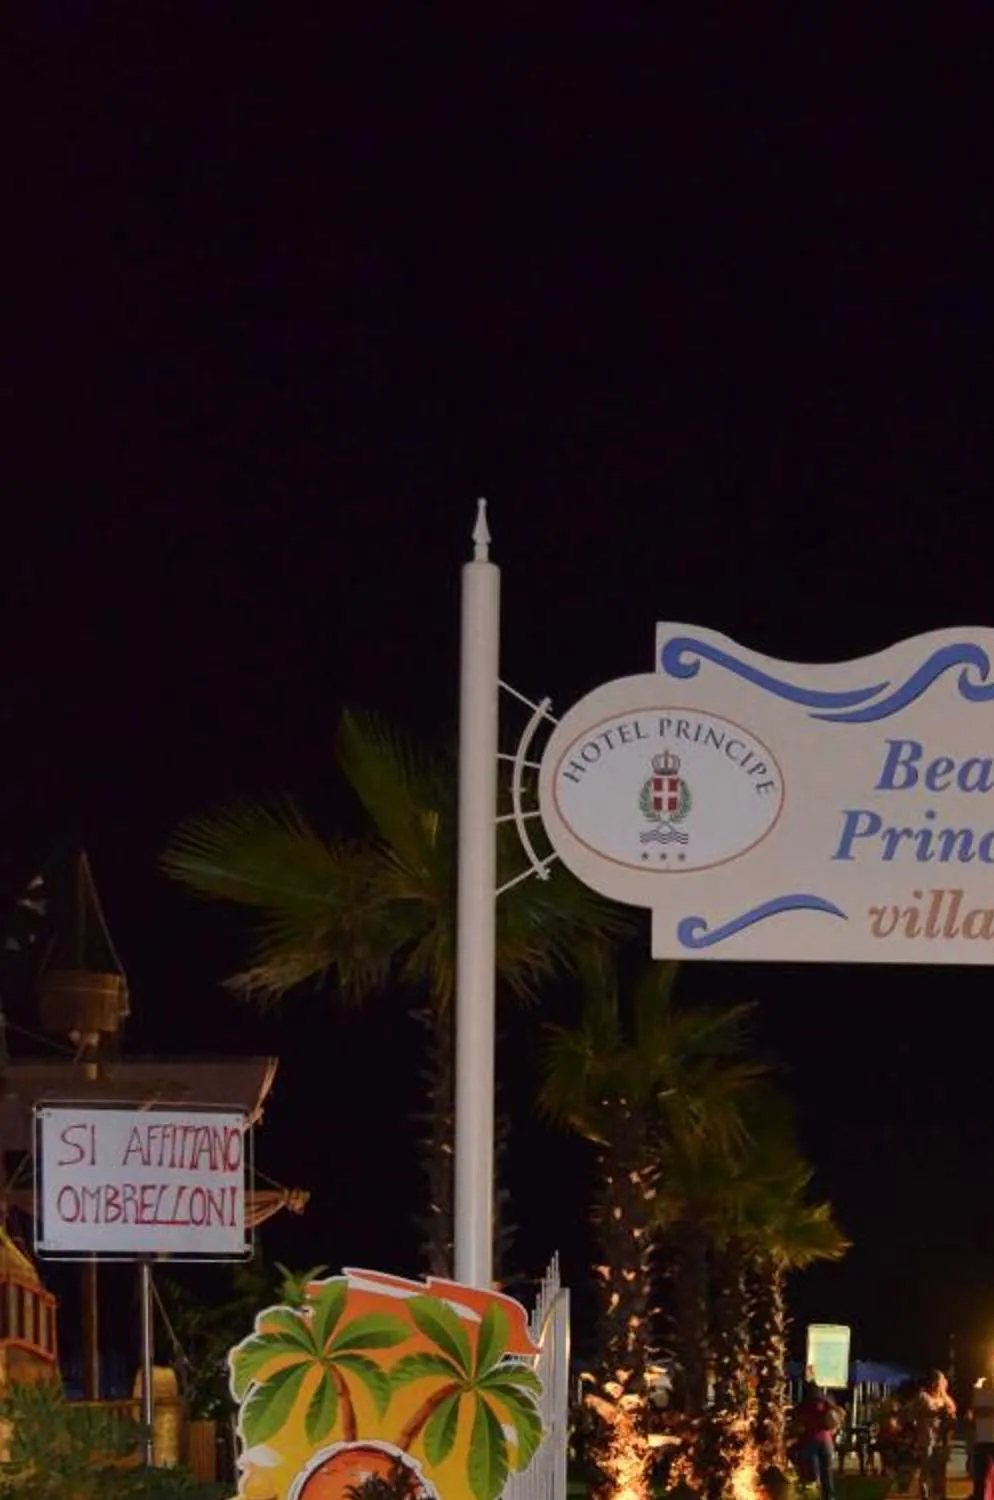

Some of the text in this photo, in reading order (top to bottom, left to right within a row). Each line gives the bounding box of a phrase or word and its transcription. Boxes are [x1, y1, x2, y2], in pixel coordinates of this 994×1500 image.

[562, 718, 776, 796] HOTEL PRINCIPE
[57, 1123, 242, 1173] SI AFFITTANO
[56, 1183, 238, 1227] OMBRELLONI
